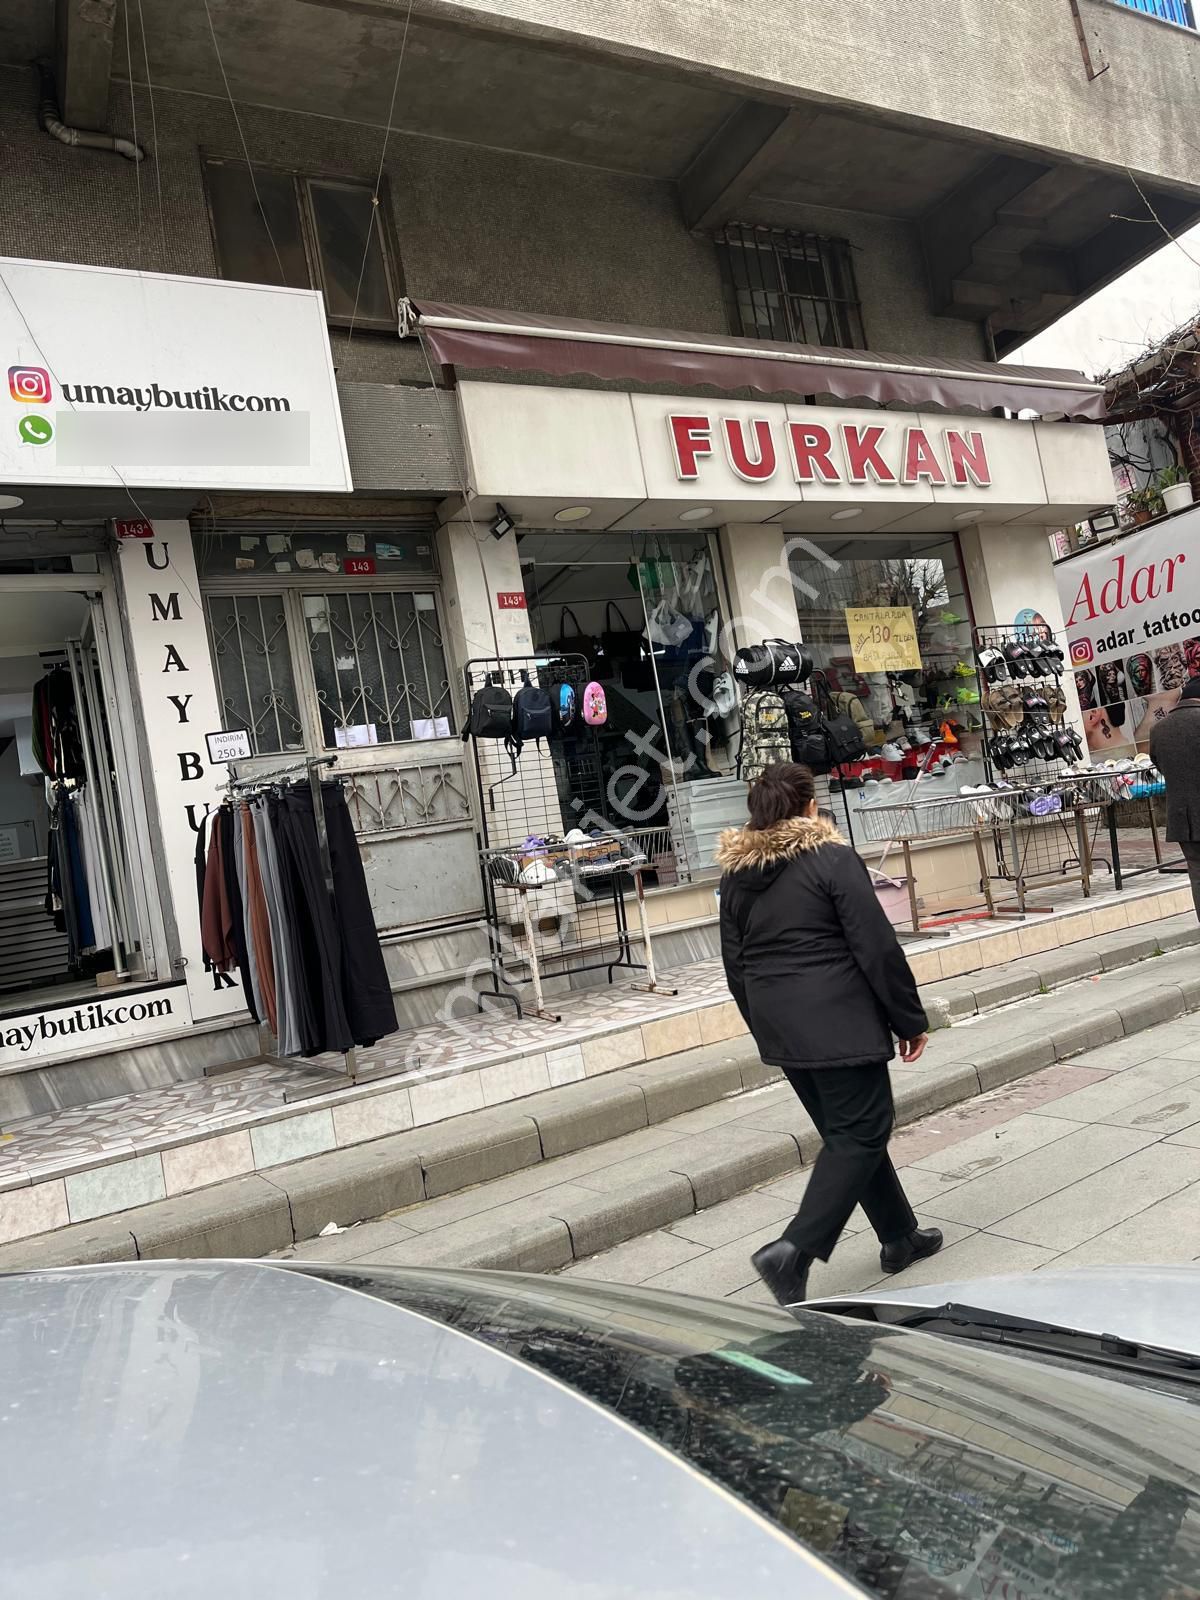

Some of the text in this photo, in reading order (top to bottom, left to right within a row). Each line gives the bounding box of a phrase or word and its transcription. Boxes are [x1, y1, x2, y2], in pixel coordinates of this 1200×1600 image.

[61, 383, 291, 411] umaybutikcom
[666, 414, 992, 487] FURKAN
[352, 561, 370, 572] 143
[1065, 554, 1186, 627] Adar
[870, 625, 891, 643] 130
[142, 542, 239, 991] UMAYBUK
[218, 748, 236, 759] 250
